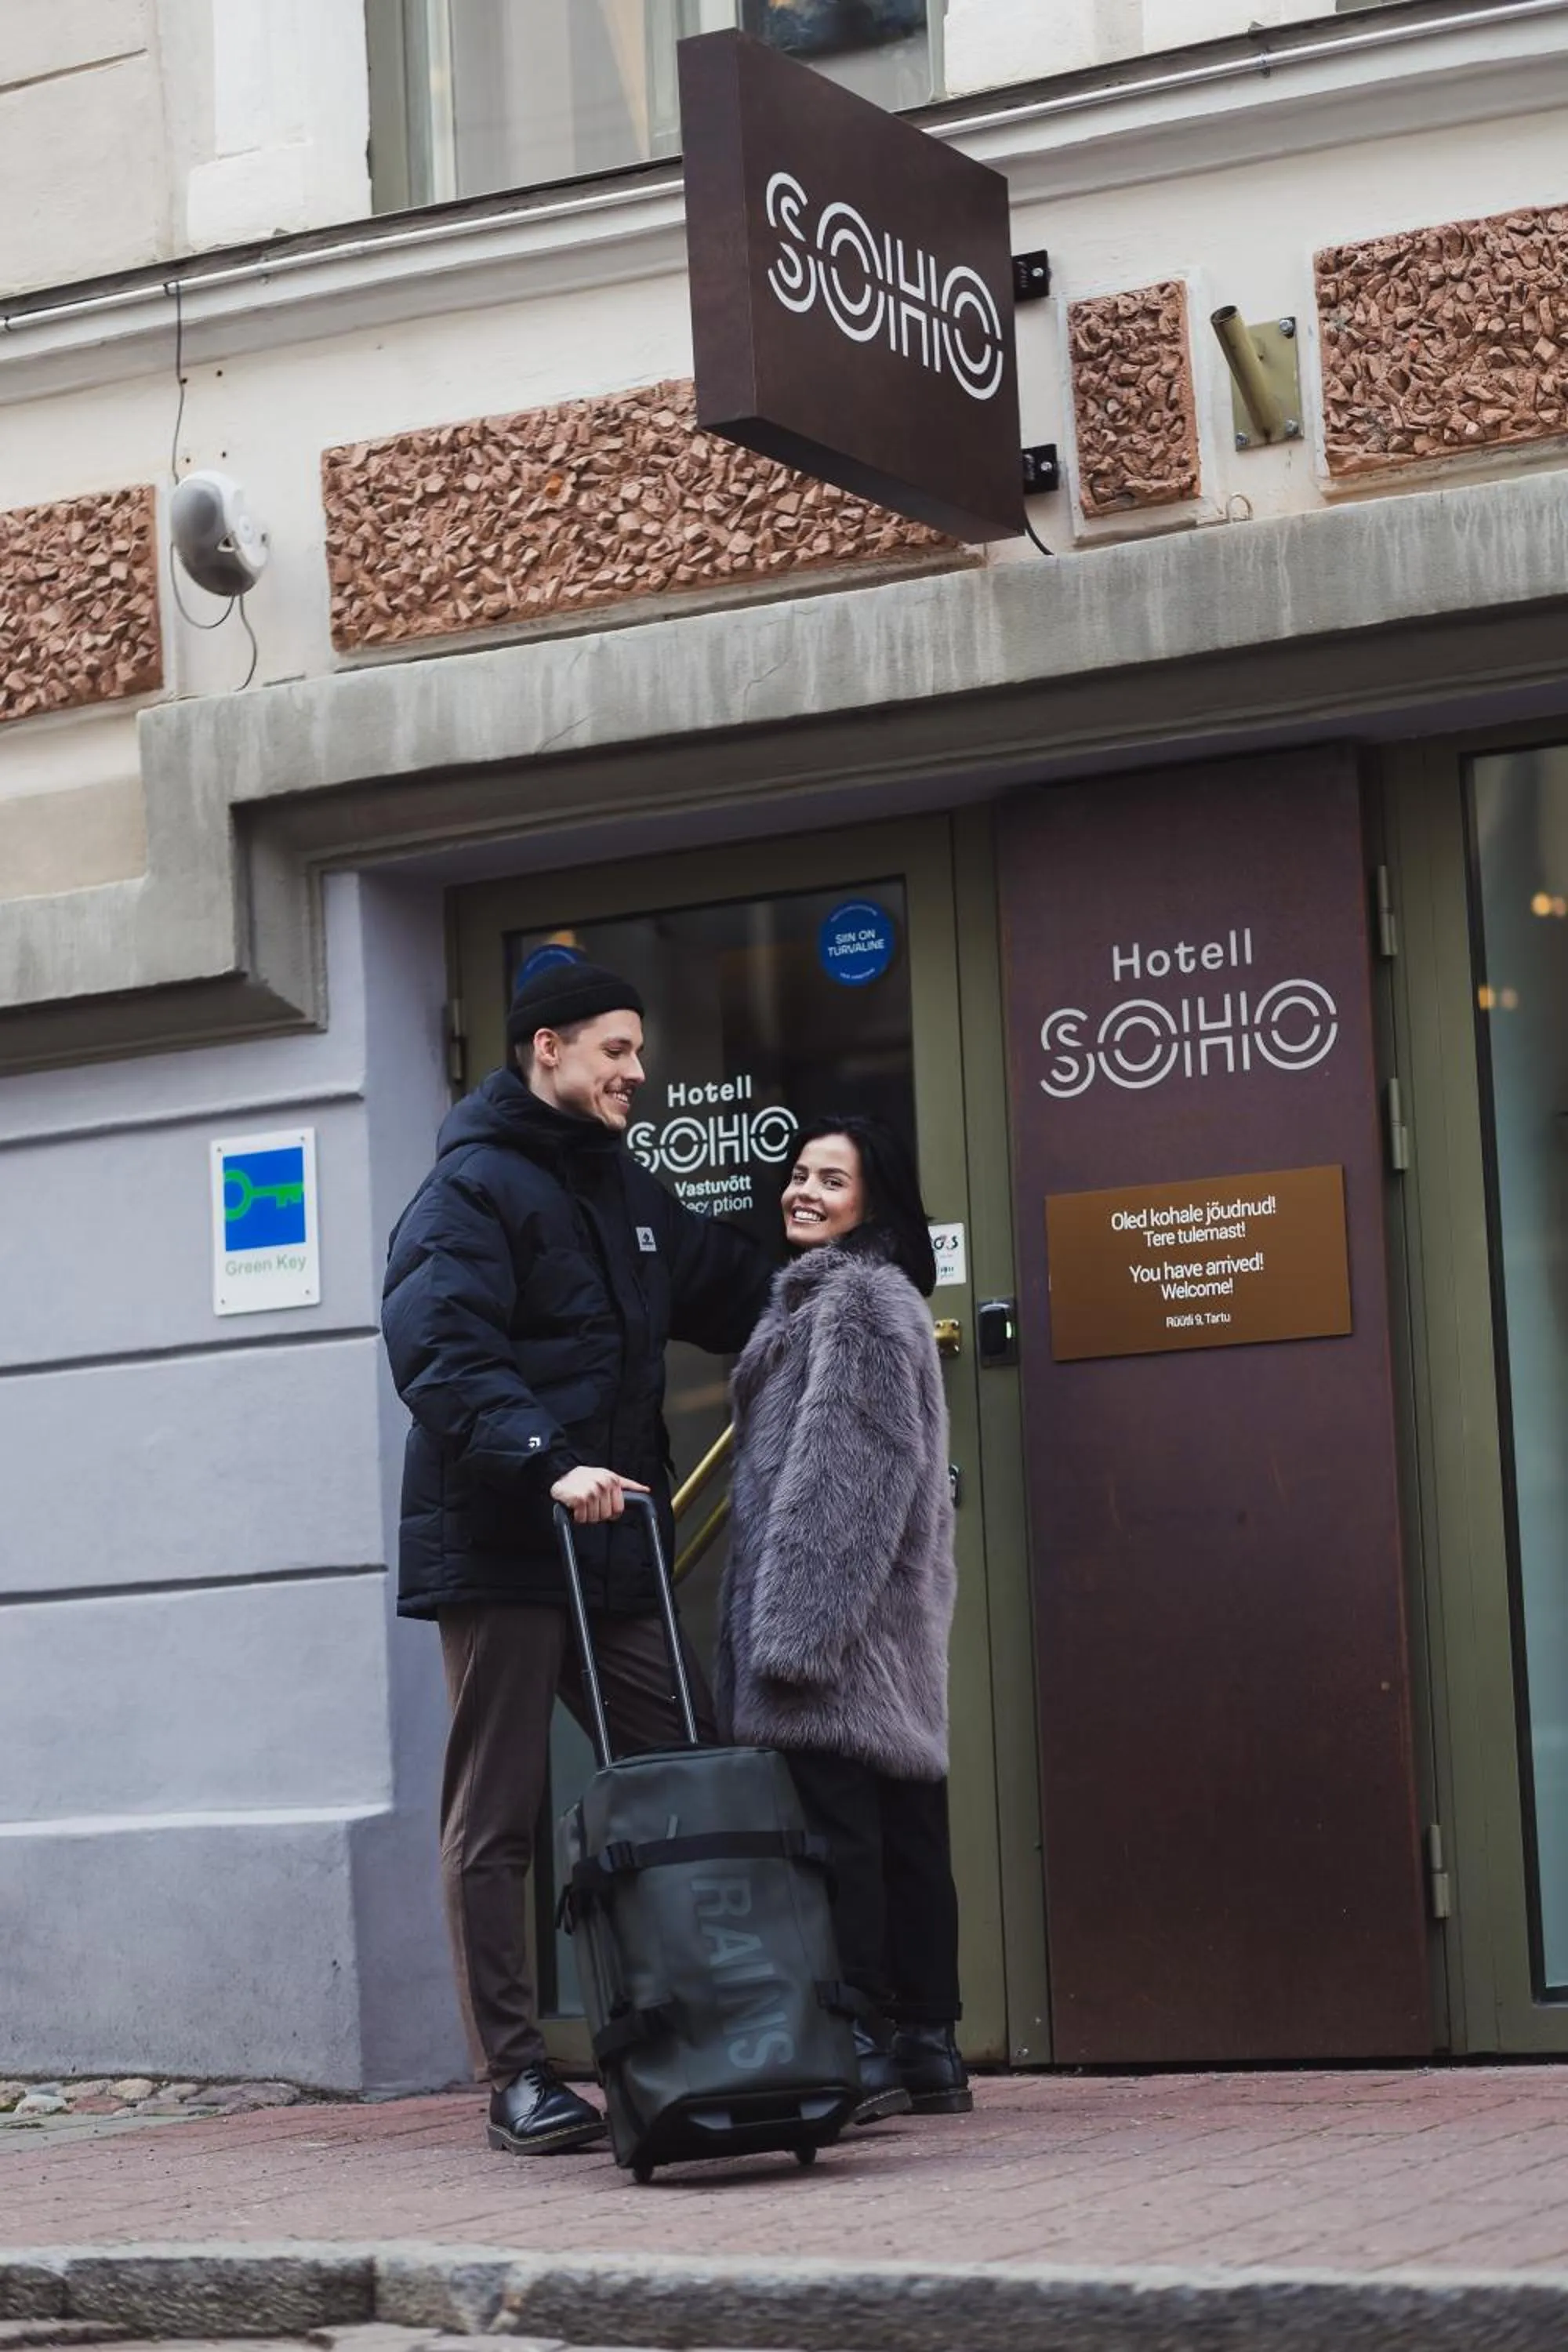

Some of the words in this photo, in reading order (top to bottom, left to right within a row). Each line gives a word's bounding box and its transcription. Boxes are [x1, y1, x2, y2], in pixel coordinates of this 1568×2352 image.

[765, 172, 1004, 401] SOHO
[828, 938, 884, 957] TURVALINE
[858, 929, 876, 941] ON
[1112, 927, 1252, 982] Hotell
[1040, 978, 1338, 1098] SOHO
[667, 1075, 752, 1108] Hotell
[627, 1106, 799, 1174] SOHO
[674, 1174, 753, 1198] Vastuvõtt
[680, 1196, 753, 1217] ecption
[1111, 1210, 1147, 1230] Oled
[1150, 1204, 1203, 1226] kohale
[1206, 1196, 1276, 1225] jõudnud!
[933, 1235, 959, 1250] GS
[1142, 1230, 1175, 1247] Tere
[1178, 1222, 1246, 1244] tulemast!
[224, 1259, 273, 1277] Green
[276, 1254, 307, 1273] Key
[1129, 1265, 1161, 1283] You
[1163, 1261, 1203, 1280] have
[1205, 1253, 1265, 1275] arrived!
[1161, 1278, 1233, 1301] Welcome!
[1205, 1312, 1232, 1324] Tartu
[691, 1875, 795, 2069] RAINS
